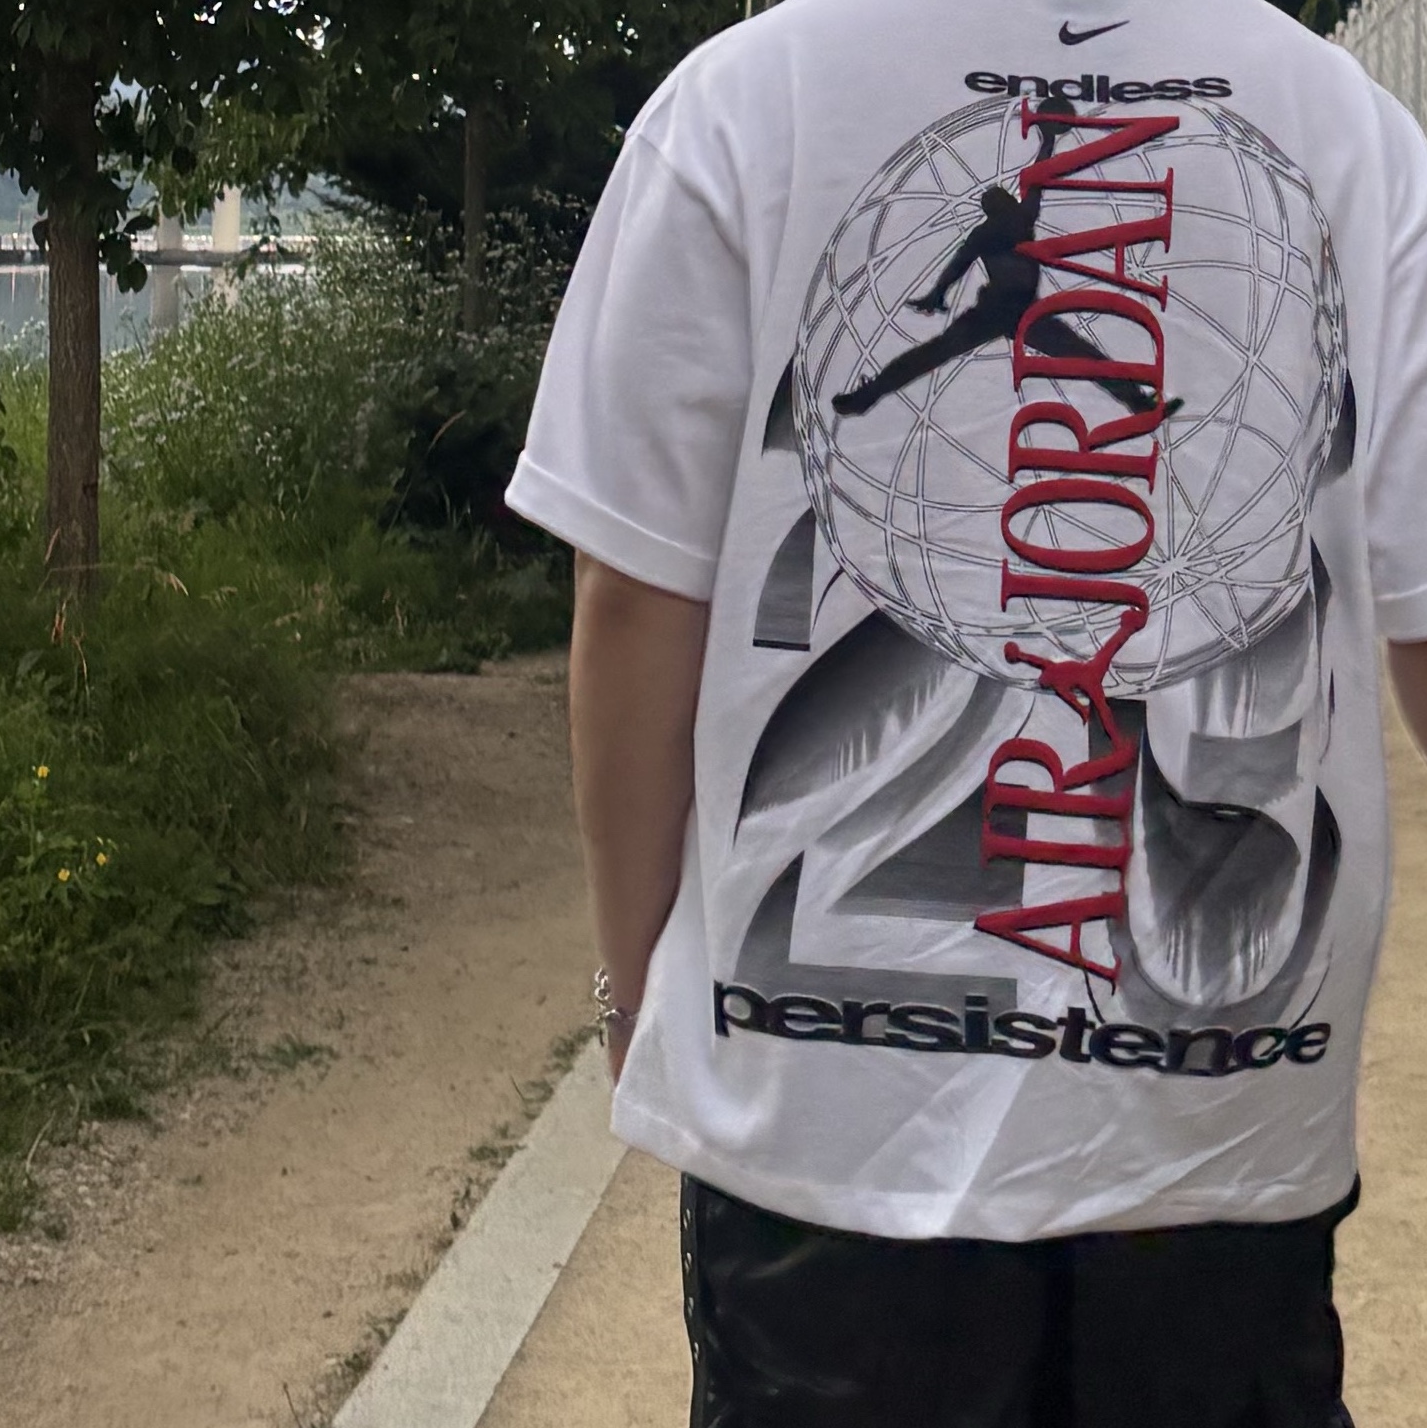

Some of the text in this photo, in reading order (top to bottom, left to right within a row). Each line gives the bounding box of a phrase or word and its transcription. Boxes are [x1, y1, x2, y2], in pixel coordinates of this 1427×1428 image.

[963, 71, 1233, 103] endless
[974, 97, 1180, 985] AIR JORDAN
[713, 980, 1332, 1076] persistence
